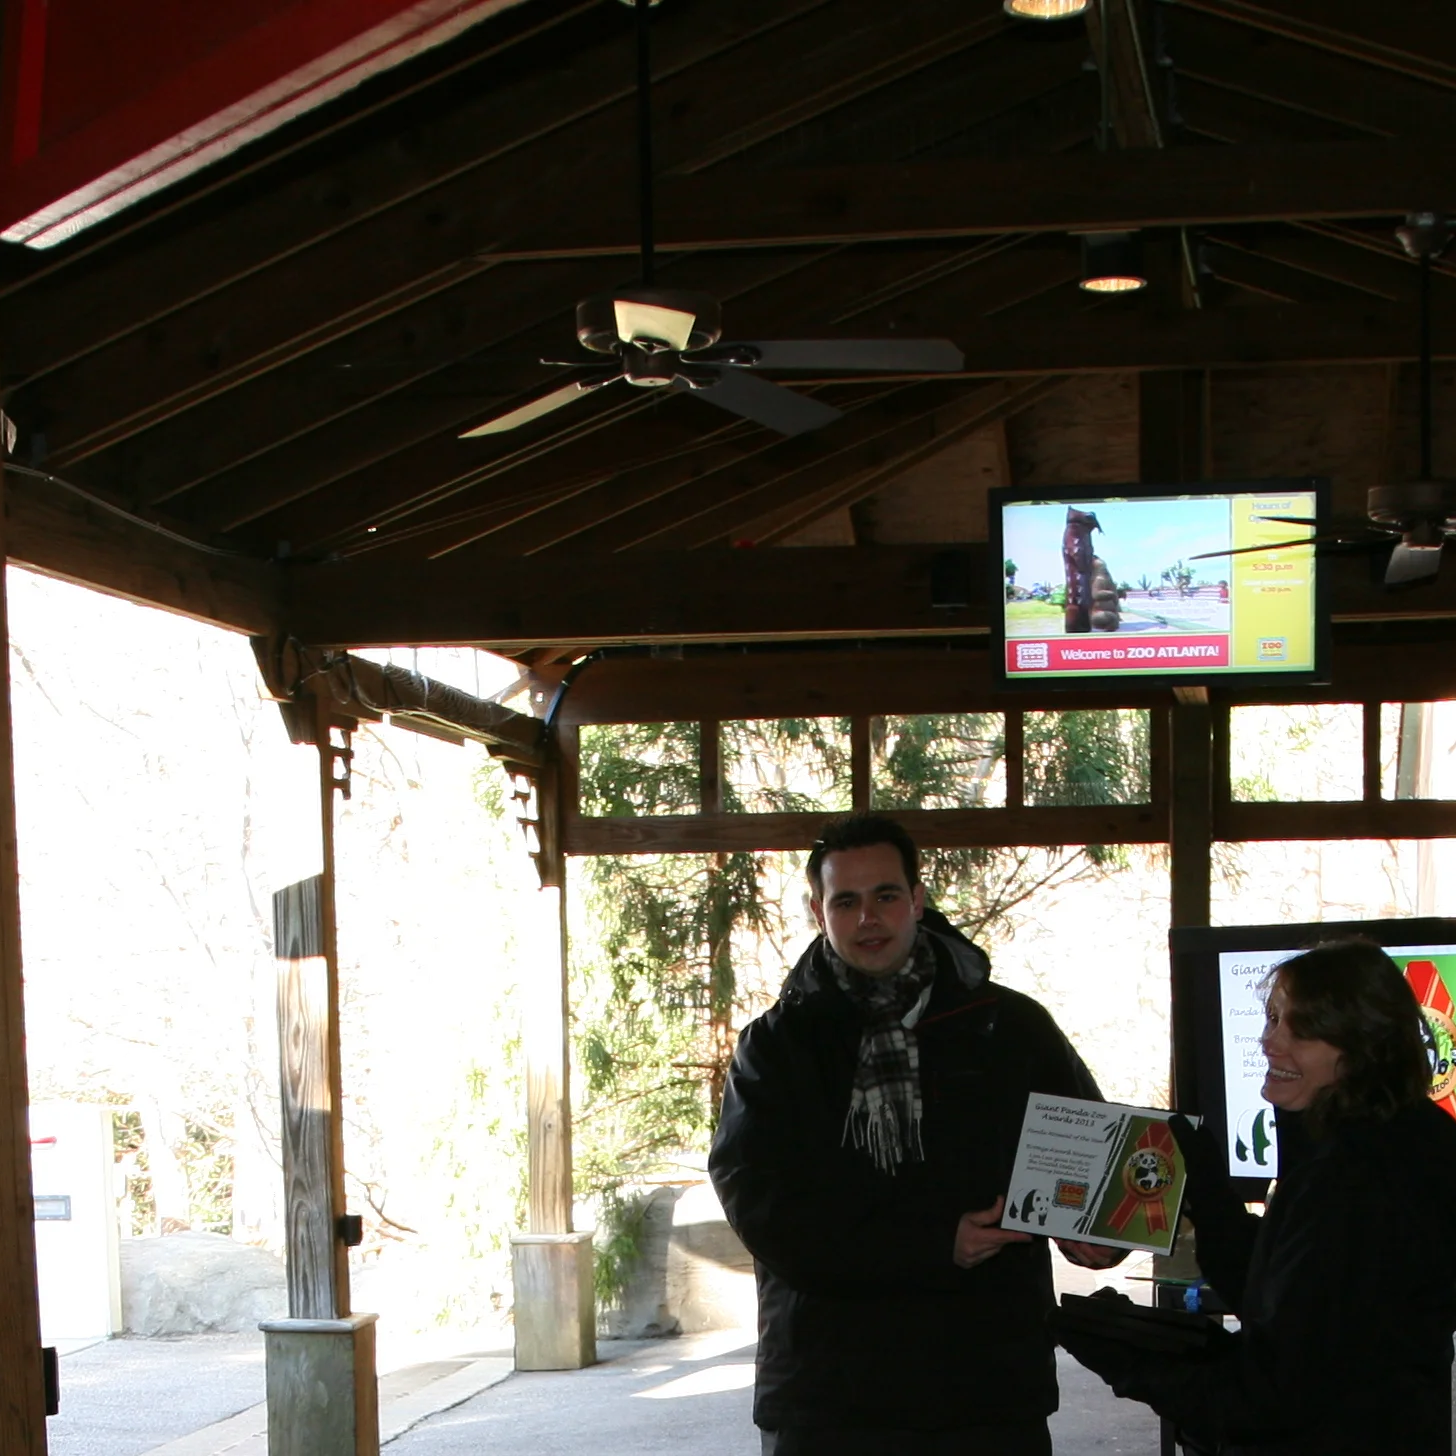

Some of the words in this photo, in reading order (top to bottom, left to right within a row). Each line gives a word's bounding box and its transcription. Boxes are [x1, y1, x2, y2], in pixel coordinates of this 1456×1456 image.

[1060, 648, 1111, 660] Welcome
[1113, 648, 1125, 660] to
[1127, 647, 1155, 659] ZOO
[1156, 645, 1220, 658] ATLANTA!
[1231, 964, 1267, 976] Giant
[1229, 1007, 1260, 1017] Panda
[1035, 1103, 1059, 1113] Giant
[1061, 1106, 1090, 1117] Panda
[1042, 1113, 1074, 1124] Awards
